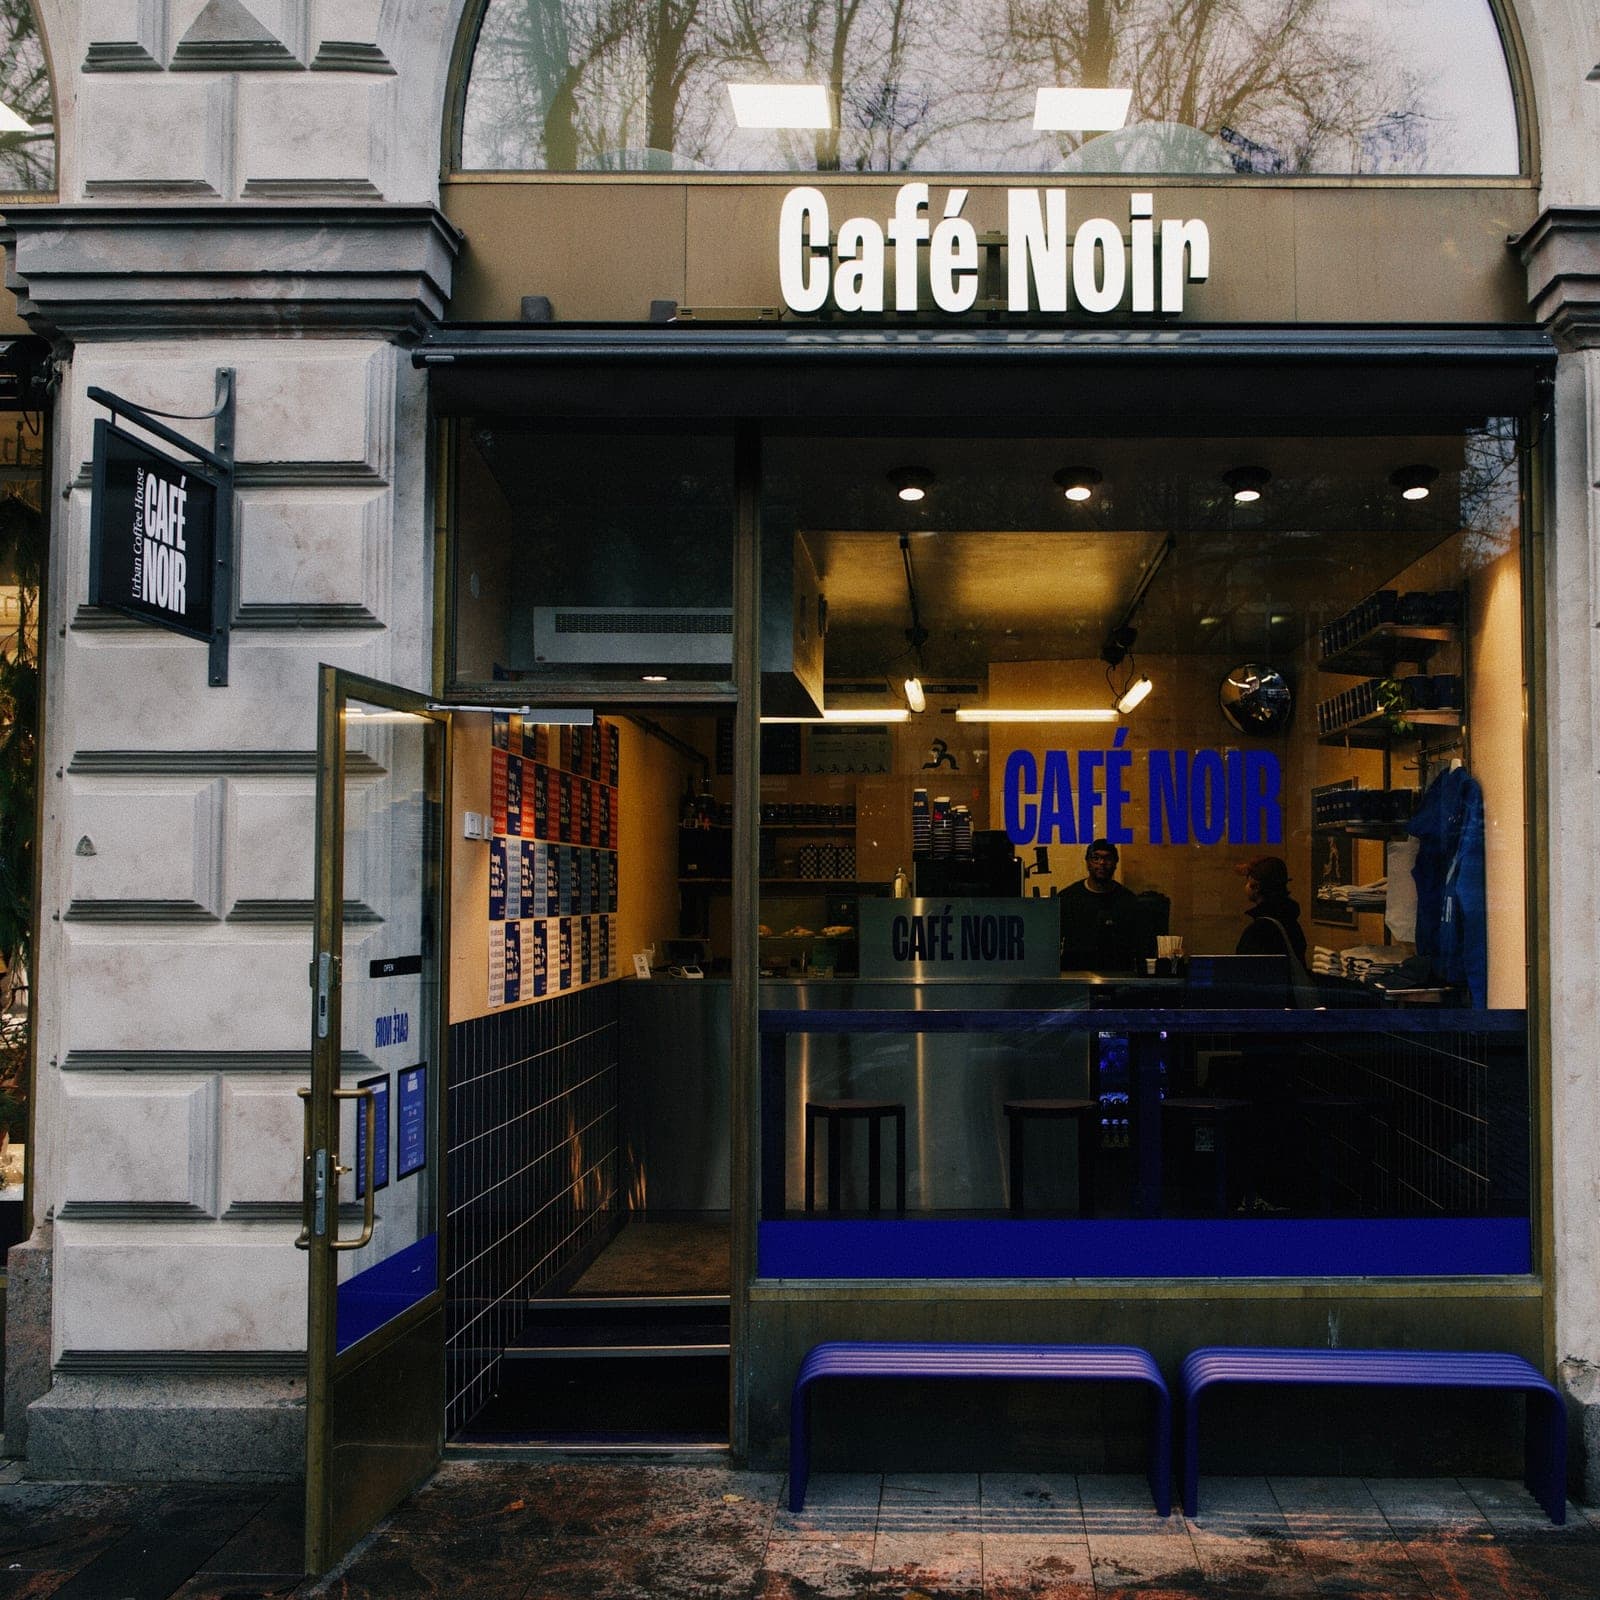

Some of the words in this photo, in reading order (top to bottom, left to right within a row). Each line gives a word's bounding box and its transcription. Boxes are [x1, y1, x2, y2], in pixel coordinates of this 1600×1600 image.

[779, 183, 979, 312] Café
[1007, 188, 1210, 312] Noir
[134, 467, 145, 511] House
[144, 473, 187, 551] CAFÉ
[132, 511, 144, 554] Coffee
[132, 558, 143, 599] Urban
[142, 538, 187, 615] NOIR
[1004, 727, 1134, 845] CAFÉ
[1148, 750, 1283, 845] NOIR
[892, 905, 954, 961] CAFÉ
[961, 915, 1025, 961] NOIR
[383, 963, 395, 972] OPEN
